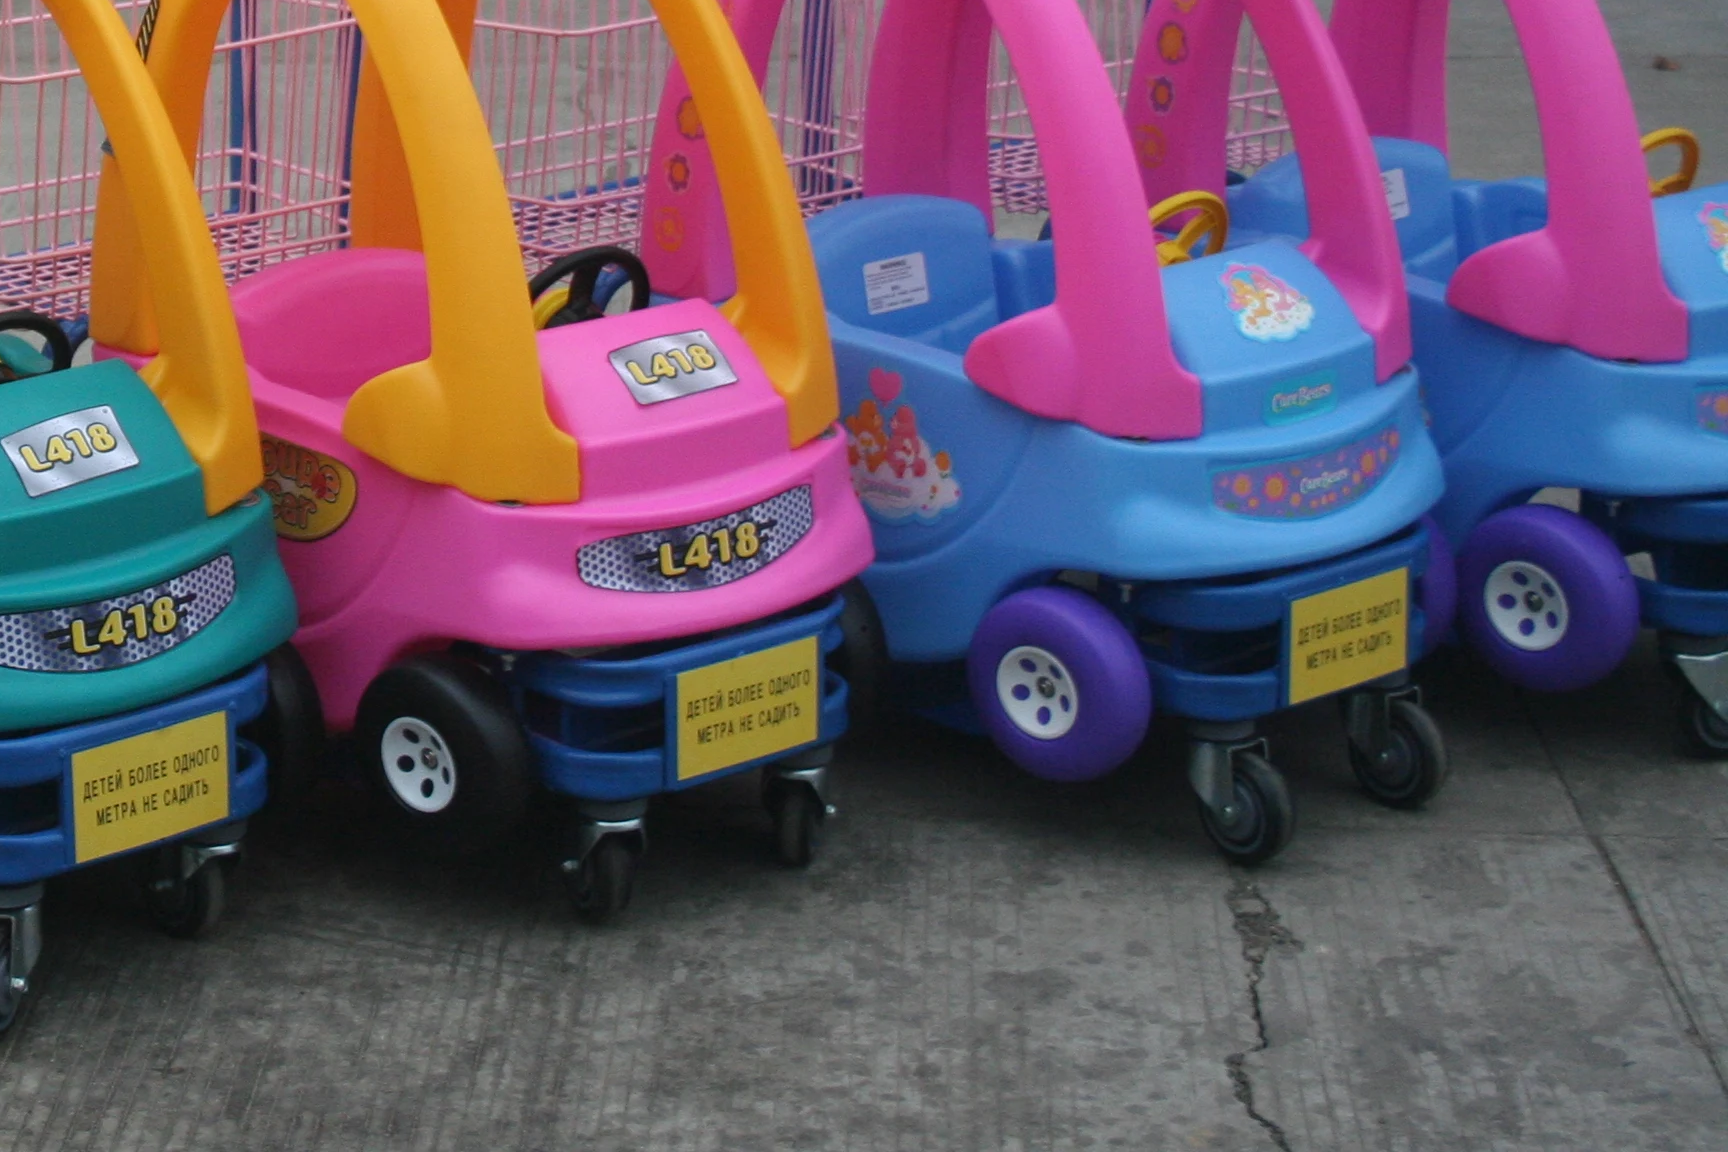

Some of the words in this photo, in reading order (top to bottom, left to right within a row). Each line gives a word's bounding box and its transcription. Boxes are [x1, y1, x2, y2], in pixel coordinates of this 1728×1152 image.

[625, 343, 716, 386] L418
[18, 422, 118, 473] L418
[658, 521, 761, 578] L418
[69, 595, 178, 656] L418
[685, 690, 723, 722] ДЕТЕЙ
[728, 681, 764, 708] БОЛЕЕ
[768, 668, 811, 696] ОДНОГО
[697, 720, 734, 745] МЕТРА
[739, 714, 753, 732] НЕ
[758, 701, 801, 727] САДИТЬ
[82, 769, 123, 803] ДЕТЕЙ
[128, 759, 168, 787] БОЛЕЕ
[173, 744, 220, 774] ОДНОГО
[95, 799, 137, 827] МЕТРА
[142, 793, 158, 813] НЕ
[163, 778, 210, 806] САДИТЬ
